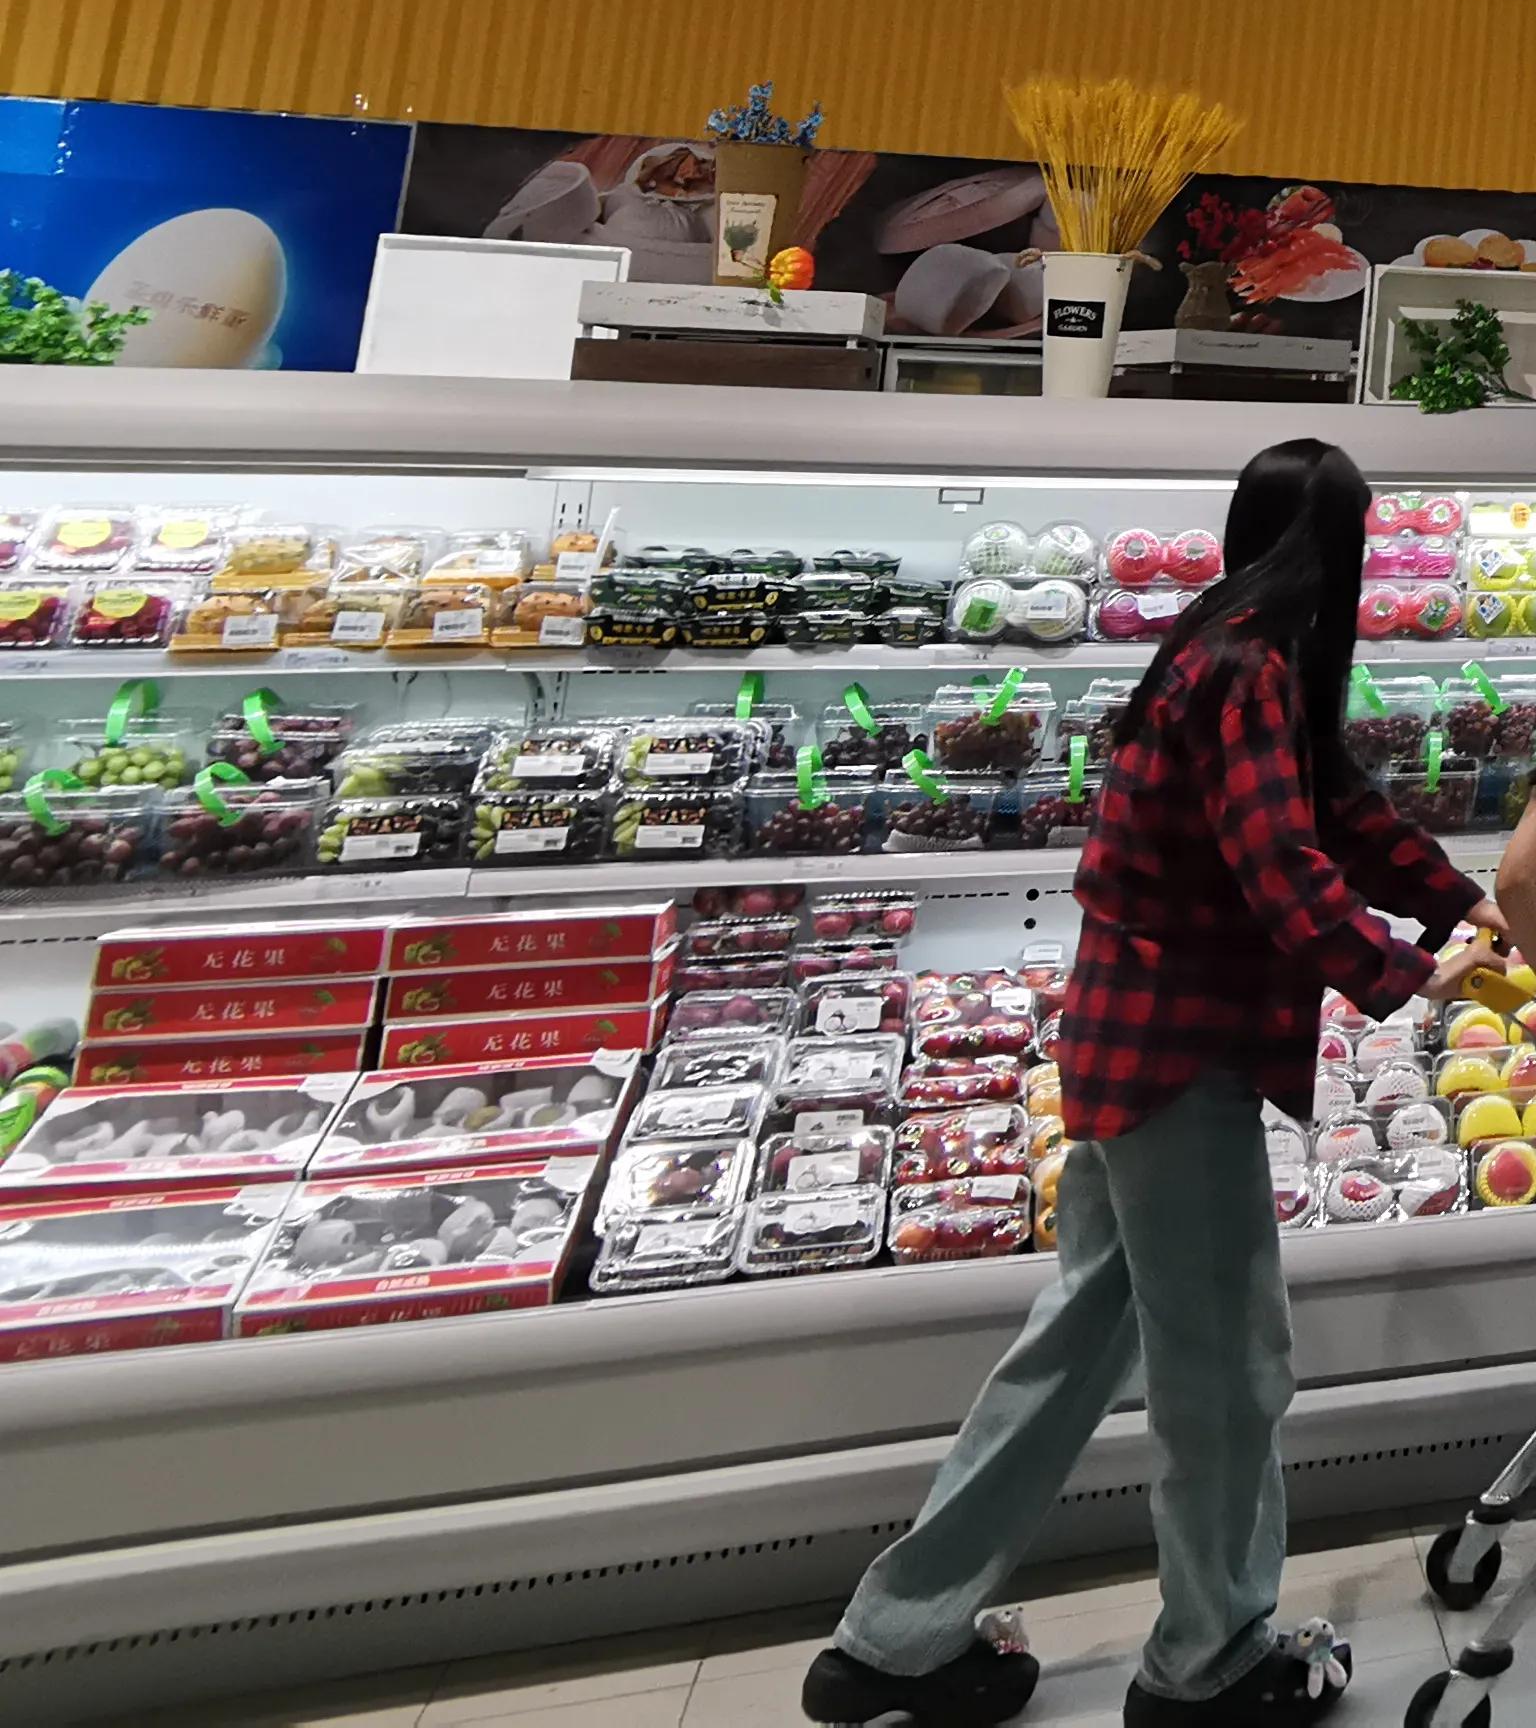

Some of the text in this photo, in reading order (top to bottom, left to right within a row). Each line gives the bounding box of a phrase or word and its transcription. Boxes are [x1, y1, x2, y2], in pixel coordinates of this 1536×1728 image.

[1053, 305, 1097, 321] FLOWERS
[489, 932, 566, 953] 无花果
[203, 948, 286, 970] 无花果
[486, 978, 564, 1000] 无花果
[191, 1000, 276, 1022] 无花果
[482, 1029, 561, 1052] 无花果
[180, 1055, 264, 1074] 无花果
